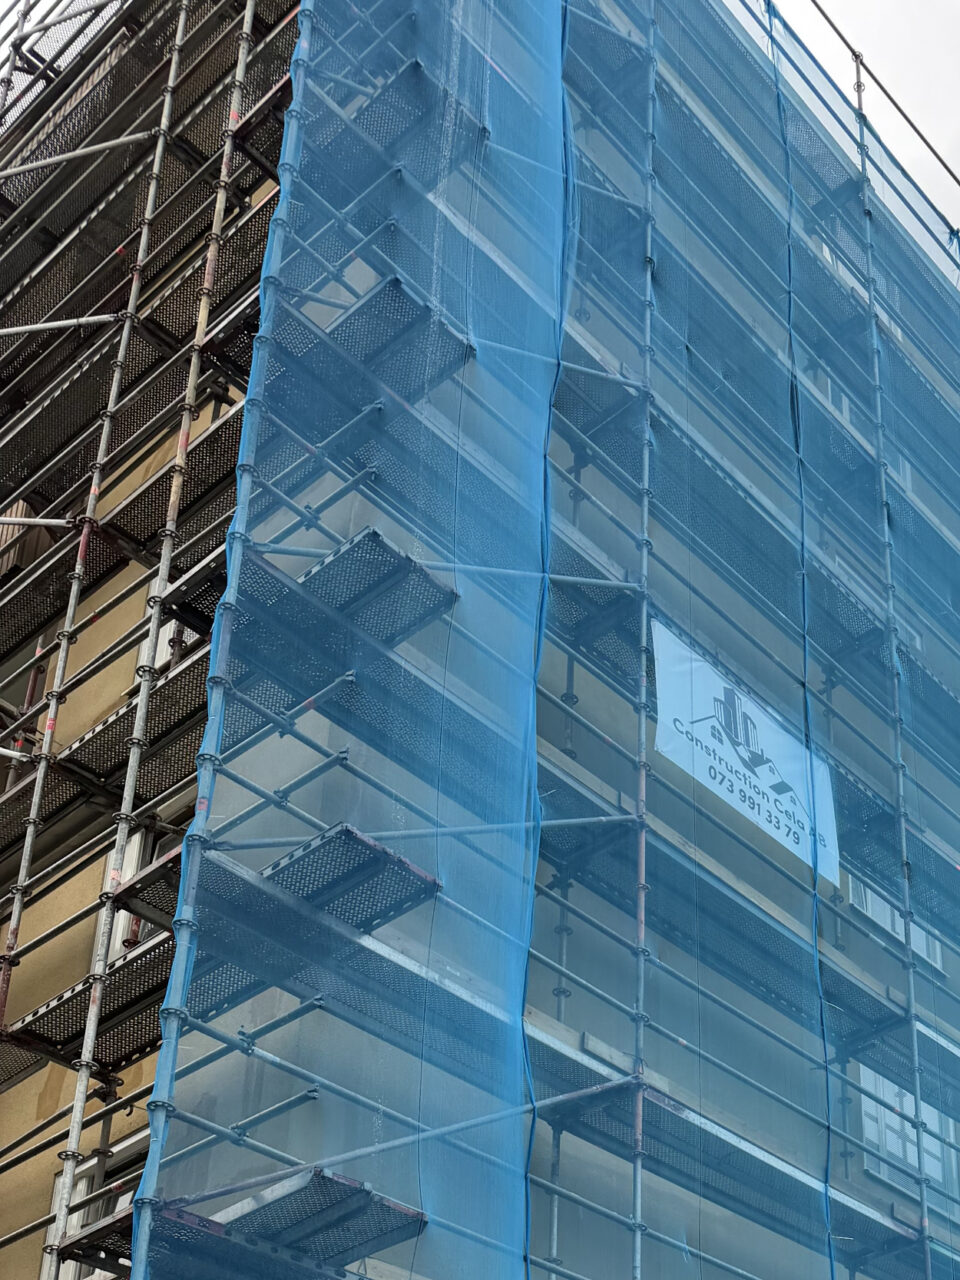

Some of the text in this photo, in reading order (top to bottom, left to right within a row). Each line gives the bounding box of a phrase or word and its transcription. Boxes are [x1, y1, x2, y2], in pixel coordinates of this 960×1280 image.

[673, 718, 770, 803] Construction
[774, 798, 805, 832] Cela
[708, 765, 800, 845] 073 991 33 79
